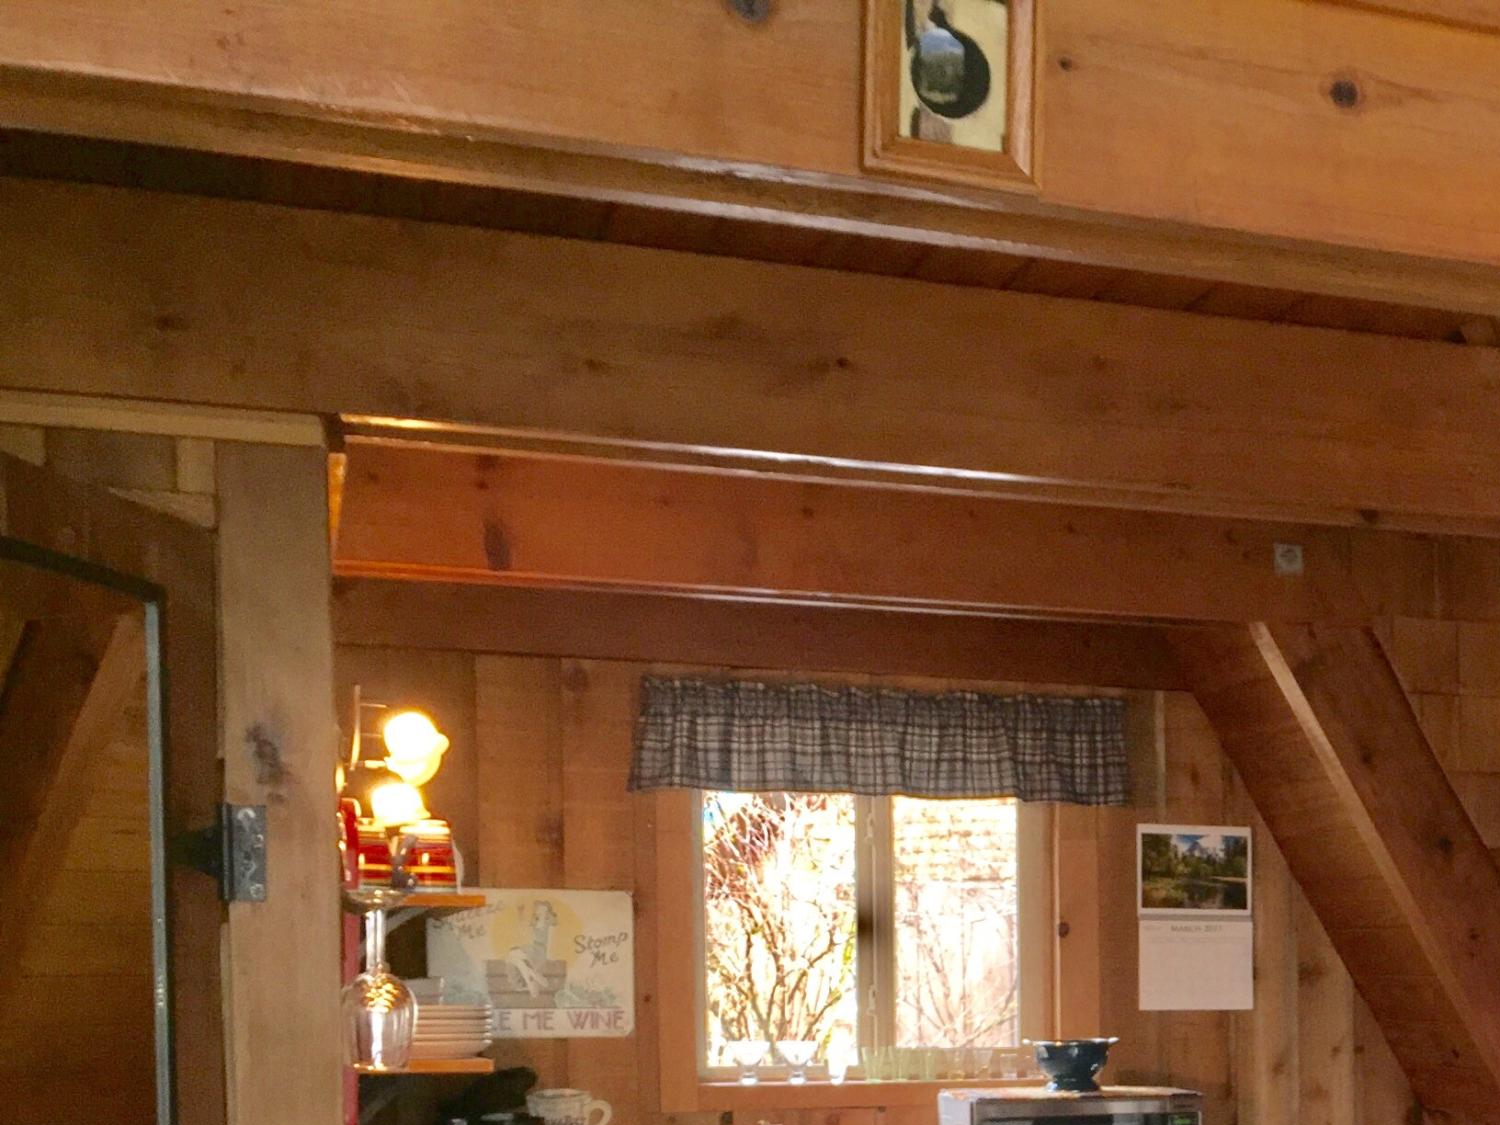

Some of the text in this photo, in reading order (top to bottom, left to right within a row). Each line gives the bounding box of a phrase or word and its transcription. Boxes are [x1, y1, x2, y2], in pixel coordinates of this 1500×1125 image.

[574, 930, 630, 955] Stomp
[589, 950, 620, 969] Me
[522, 1010, 555, 1031] ME
[567, 1009, 626, 1031] WINE
